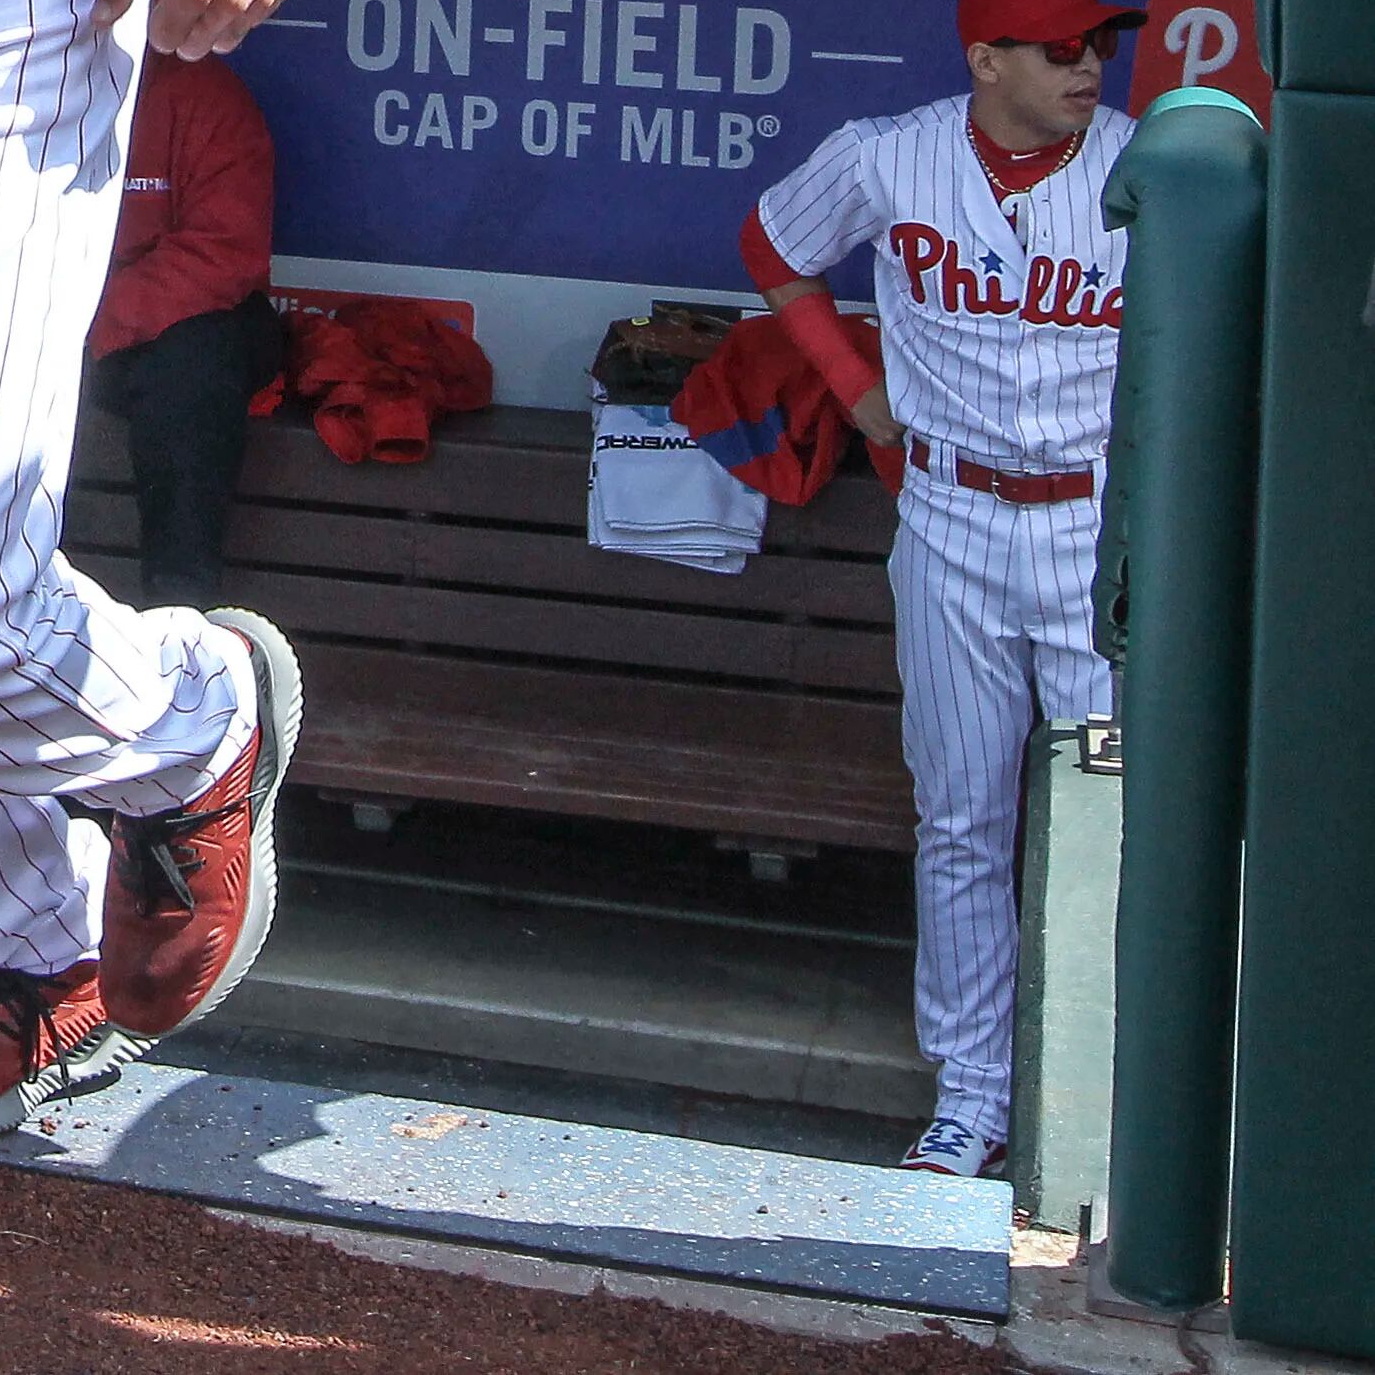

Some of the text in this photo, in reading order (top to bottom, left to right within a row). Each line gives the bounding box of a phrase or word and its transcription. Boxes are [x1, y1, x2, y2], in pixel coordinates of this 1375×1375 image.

[373, 89, 499, 152] CAP
[520, 98, 597, 159] OF
[889, 220, 1126, 329] Phillie
[596, 433, 700, 452] OWERAD
